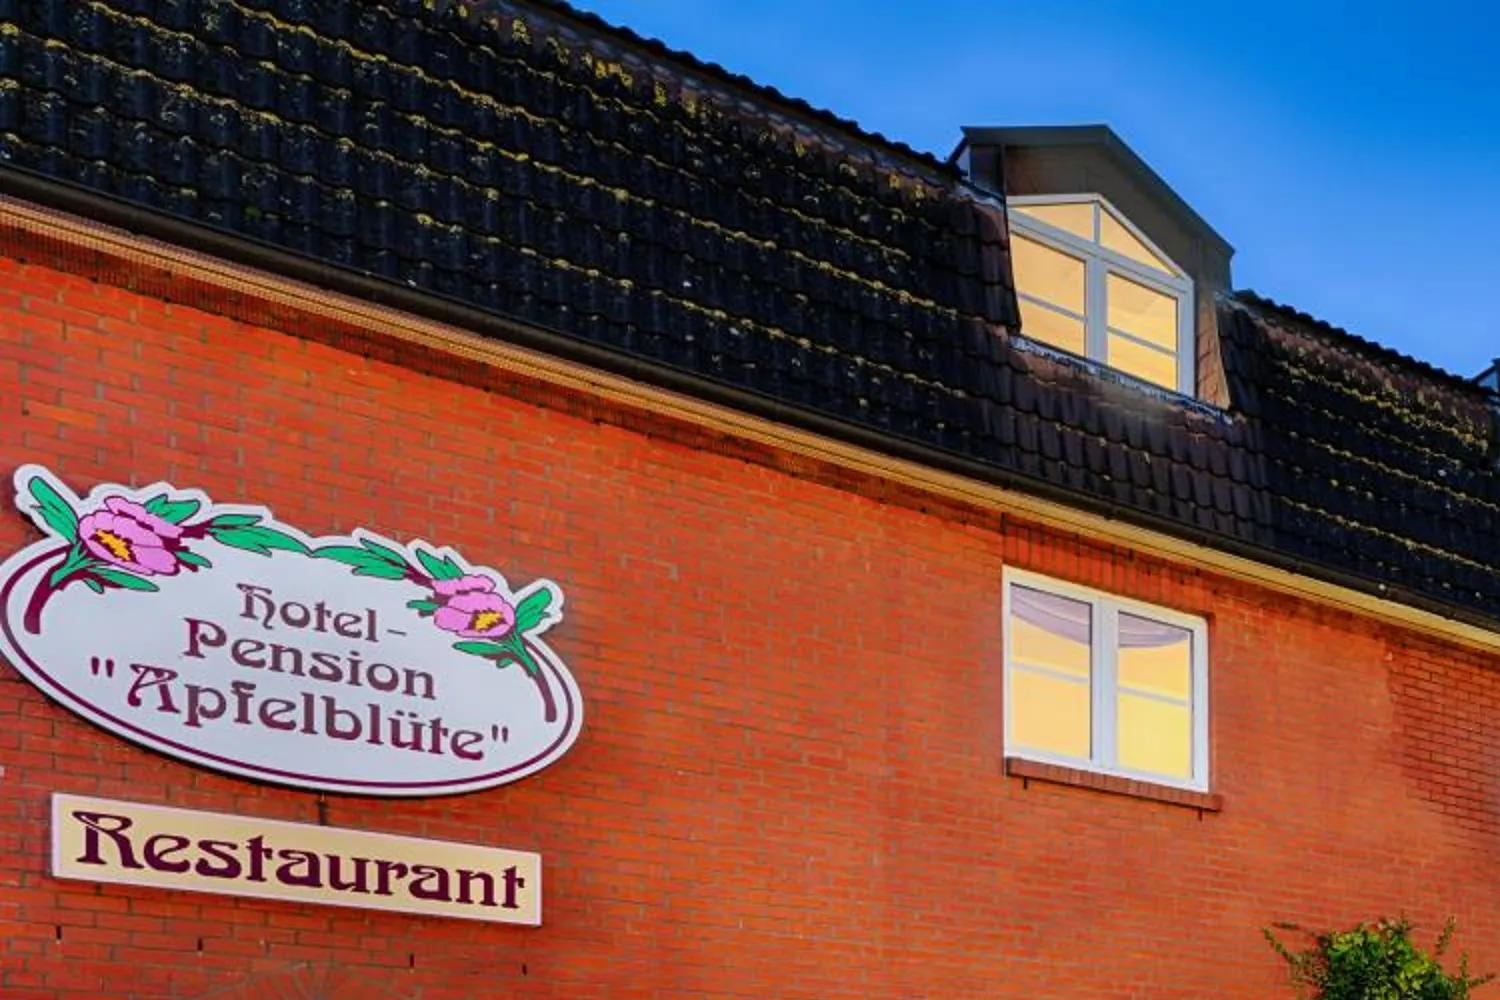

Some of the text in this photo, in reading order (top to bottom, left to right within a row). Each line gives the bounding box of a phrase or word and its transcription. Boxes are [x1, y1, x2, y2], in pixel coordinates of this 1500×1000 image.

[184, 617, 436, 700] Pension
[90, 657, 509, 761] "Apfelblüte"
[72, 811, 525, 909] Restaurant
